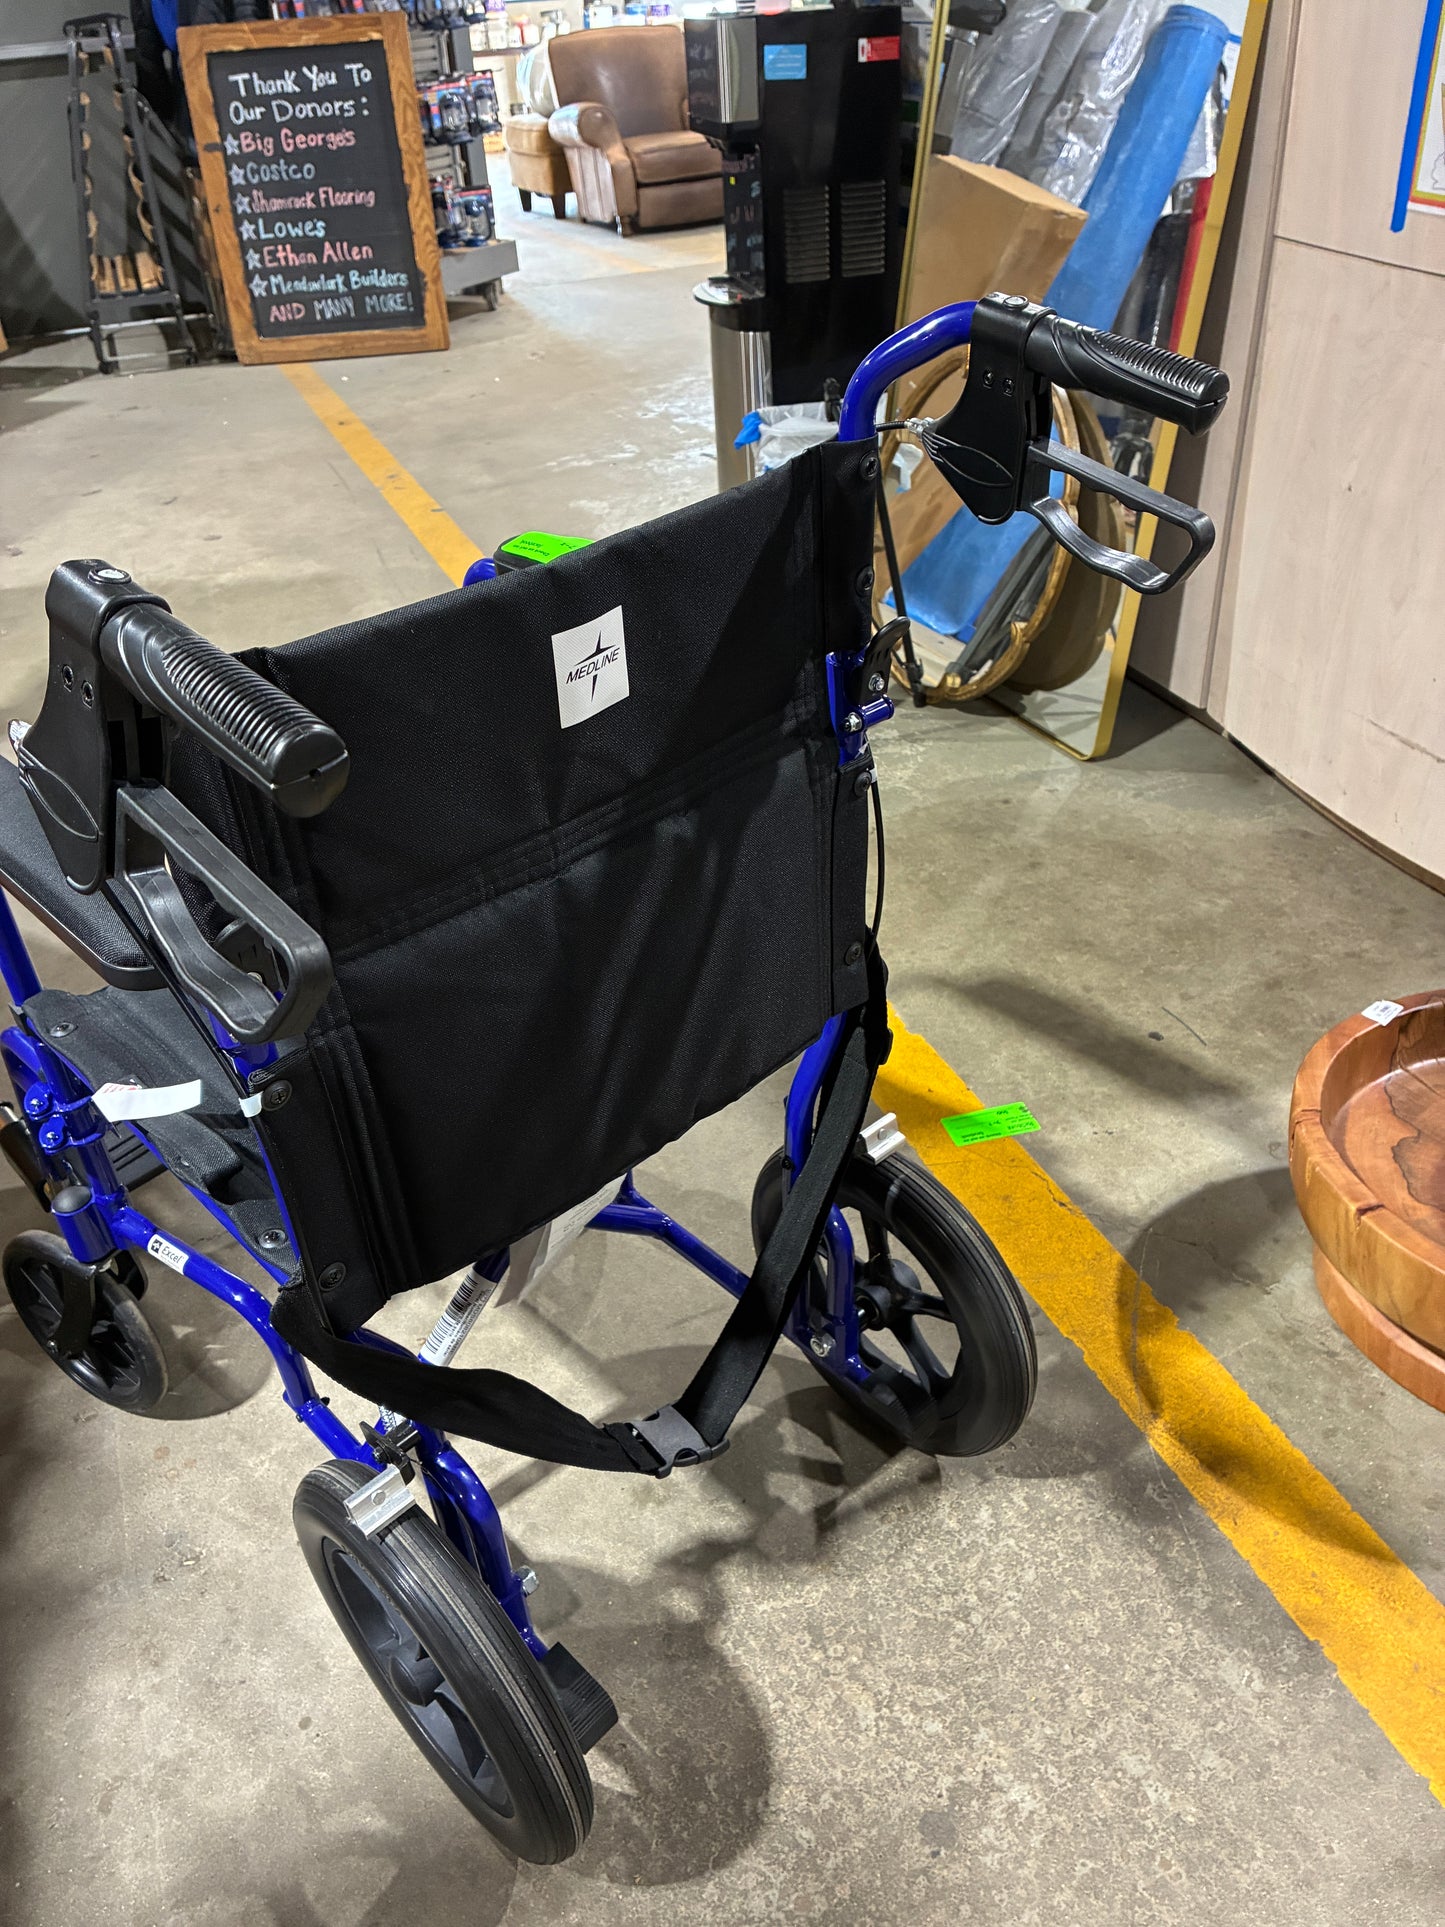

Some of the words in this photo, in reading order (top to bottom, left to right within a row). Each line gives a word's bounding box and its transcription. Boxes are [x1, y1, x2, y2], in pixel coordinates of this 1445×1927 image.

[228, 69, 301, 98] Thank
[302, 64, 338, 92] You
[344, 62, 373, 87] To
[229, 101, 266, 125] Our
[239, 131, 275, 157] Big
[246, 158, 316, 184] Costco
[318, 186, 376, 208] Flooring
[262, 243, 318, 267] Ethan
[322, 240, 374, 264] Allen
[349, 268, 409, 290] Builders
[269, 302, 306, 323] AND
[313, 296, 356, 321] MANY
[565, 647, 620, 684] MEDLINE
[161, 1246, 182, 1263] Excel
